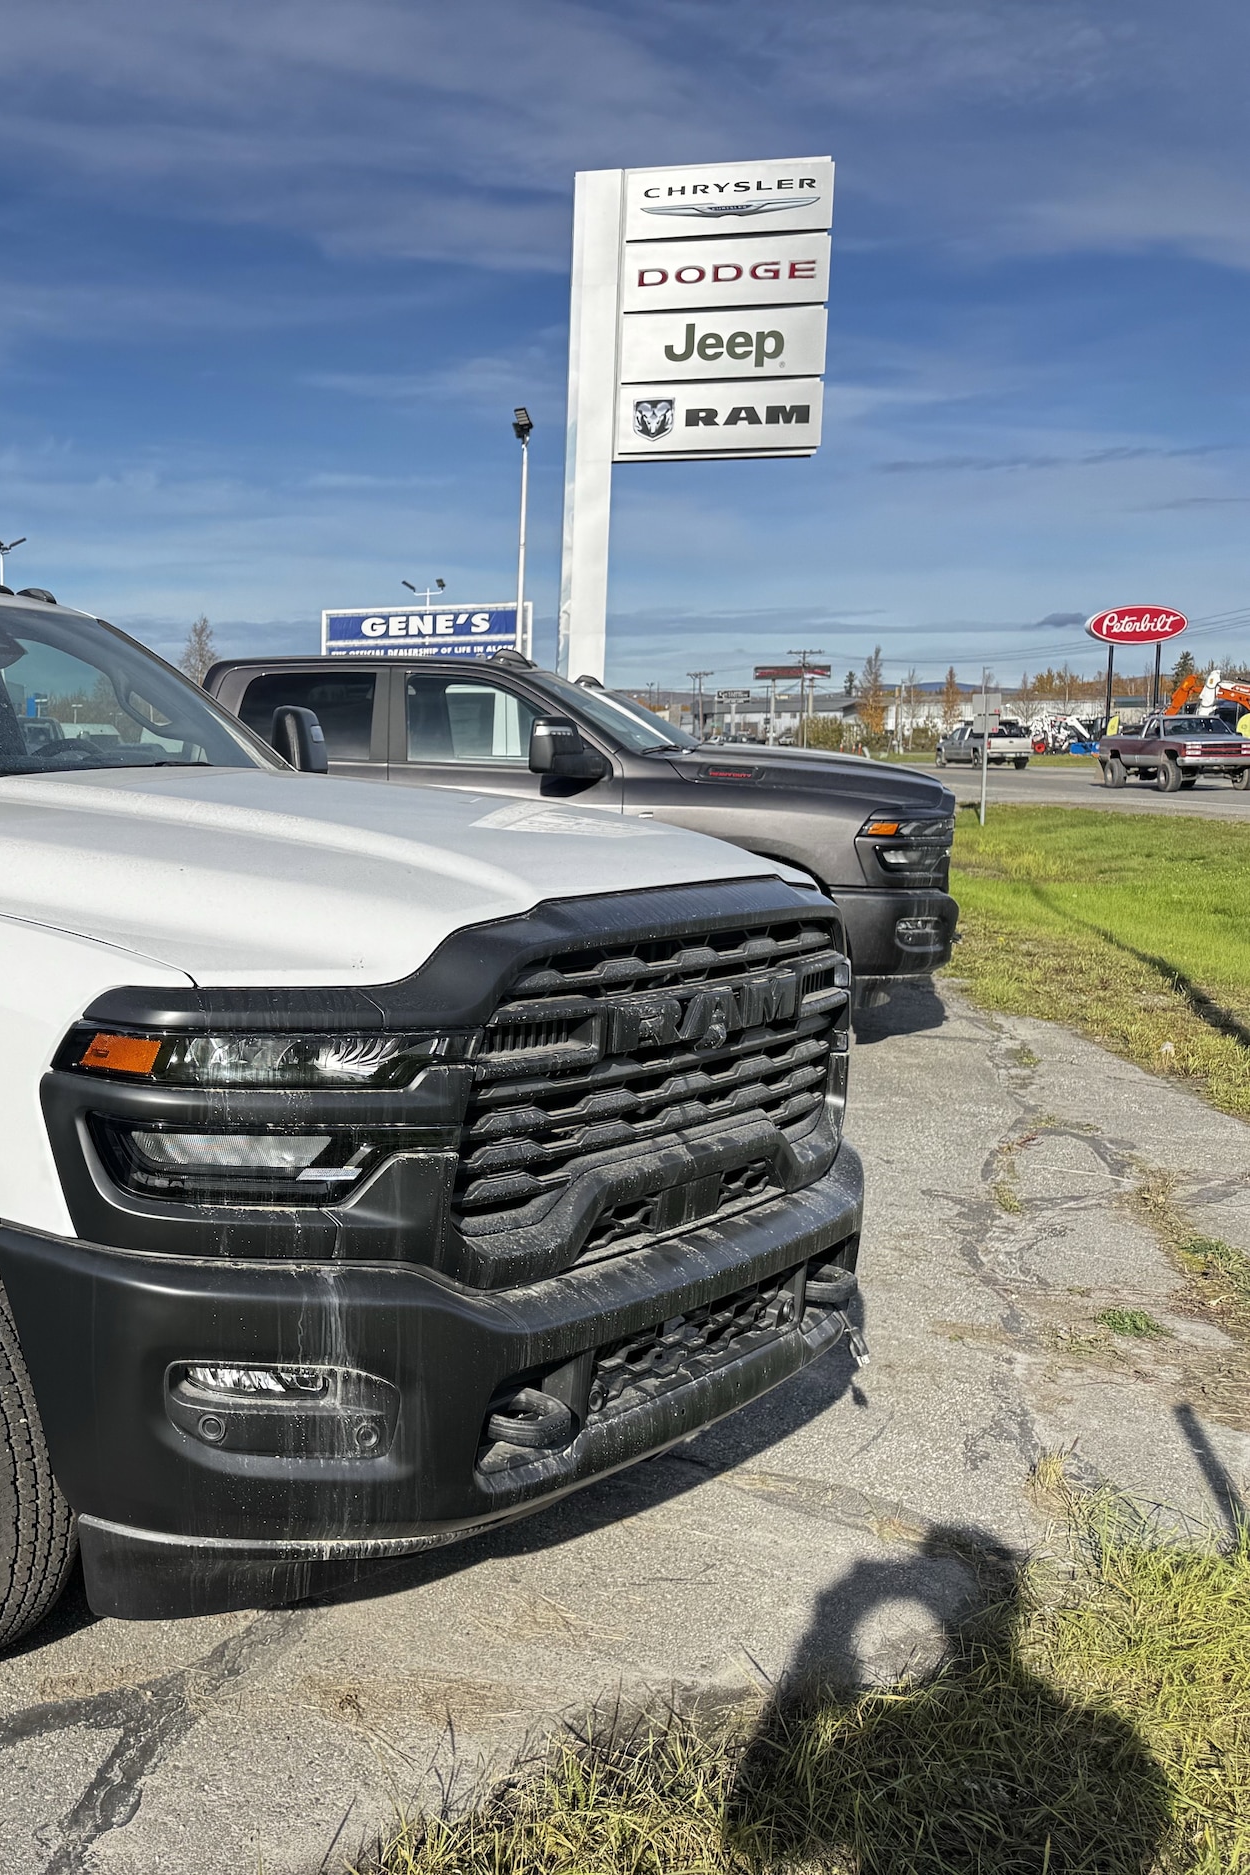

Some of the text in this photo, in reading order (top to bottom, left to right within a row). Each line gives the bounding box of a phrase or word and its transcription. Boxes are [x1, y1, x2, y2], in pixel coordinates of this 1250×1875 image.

[644, 178, 817, 198] CHRYSLER
[637, 259, 817, 287] DODGE
[664, 323, 785, 368] Jeep
[685, 404, 811, 427] RAM
[360, 612, 491, 637] GENE'S
[1102, 613, 1181, 635] Peterbilt
[387, 647, 439, 657] DEALERSHIP
[440, 646, 453, 654] OF
[454, 645, 471, 654] LIFE
[473, 644, 484, 653] IN
[612, 970, 797, 1053] RAM
